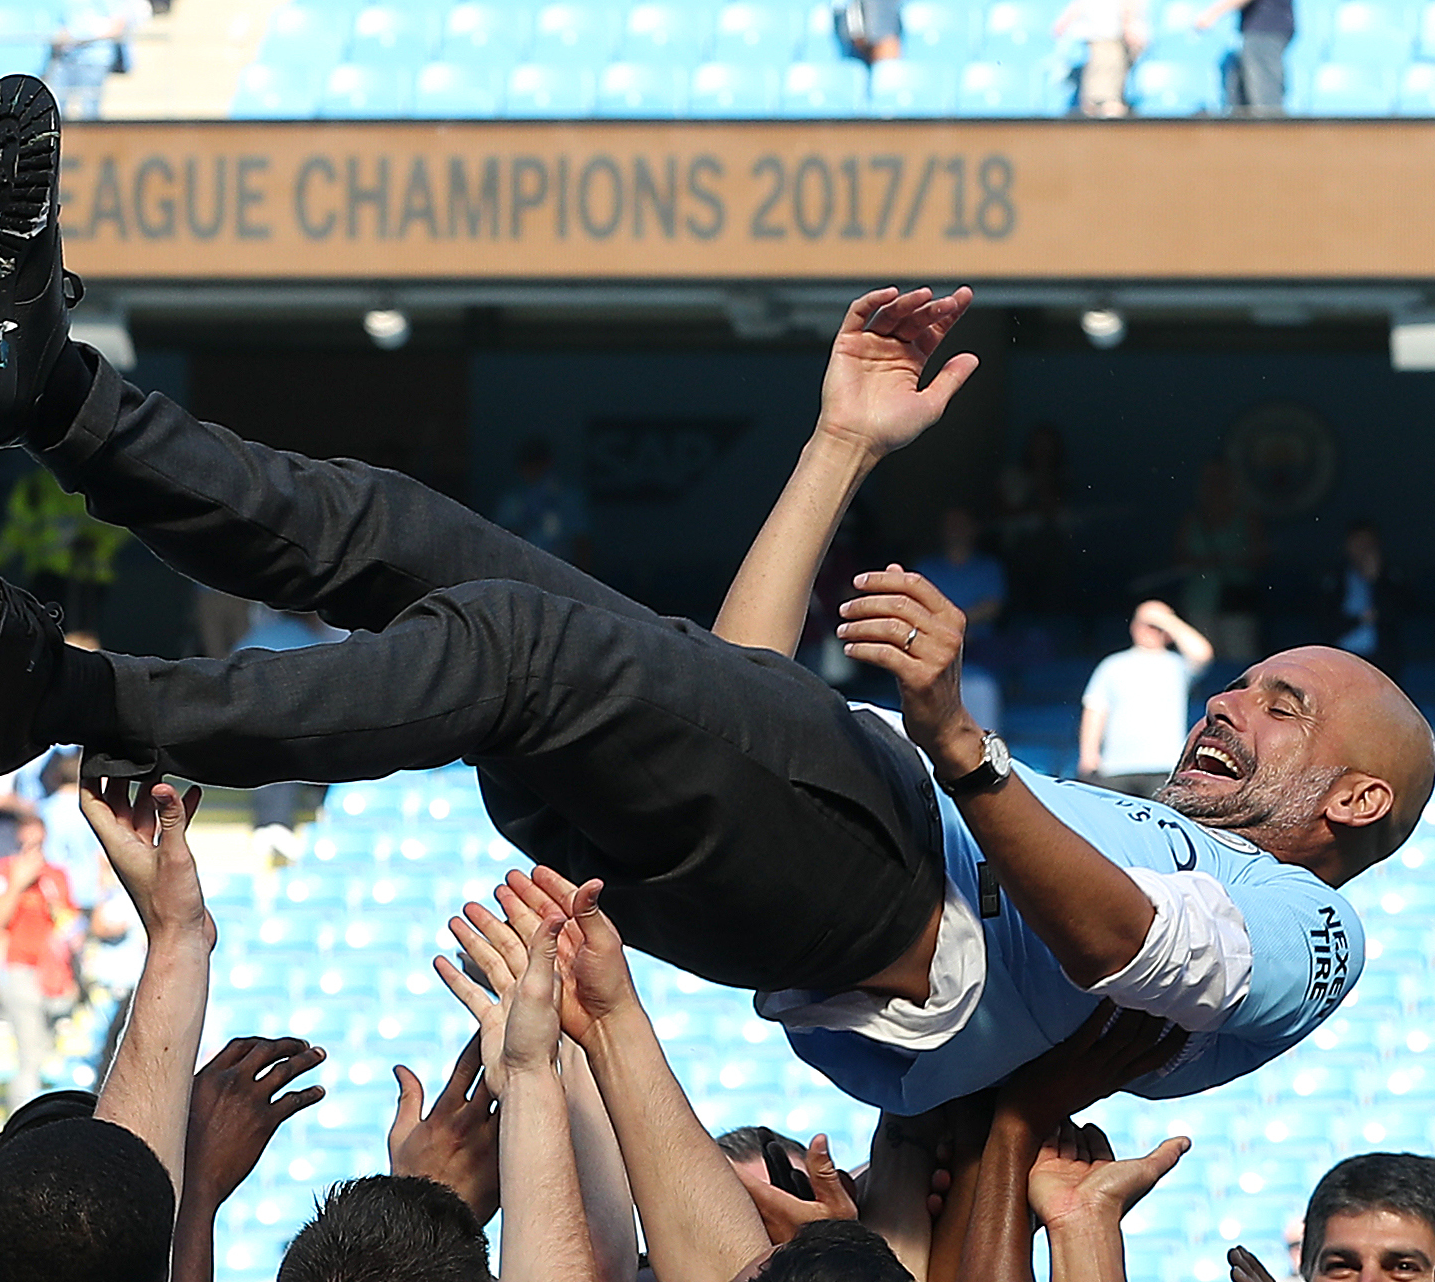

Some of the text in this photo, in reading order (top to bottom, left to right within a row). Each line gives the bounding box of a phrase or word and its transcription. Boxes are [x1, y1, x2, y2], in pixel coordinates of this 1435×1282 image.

[292, 154, 726, 241] CHAMPIONS
[749, 154, 1017, 241] 2017/18
[1308, 929, 1332, 1001] TIRE
